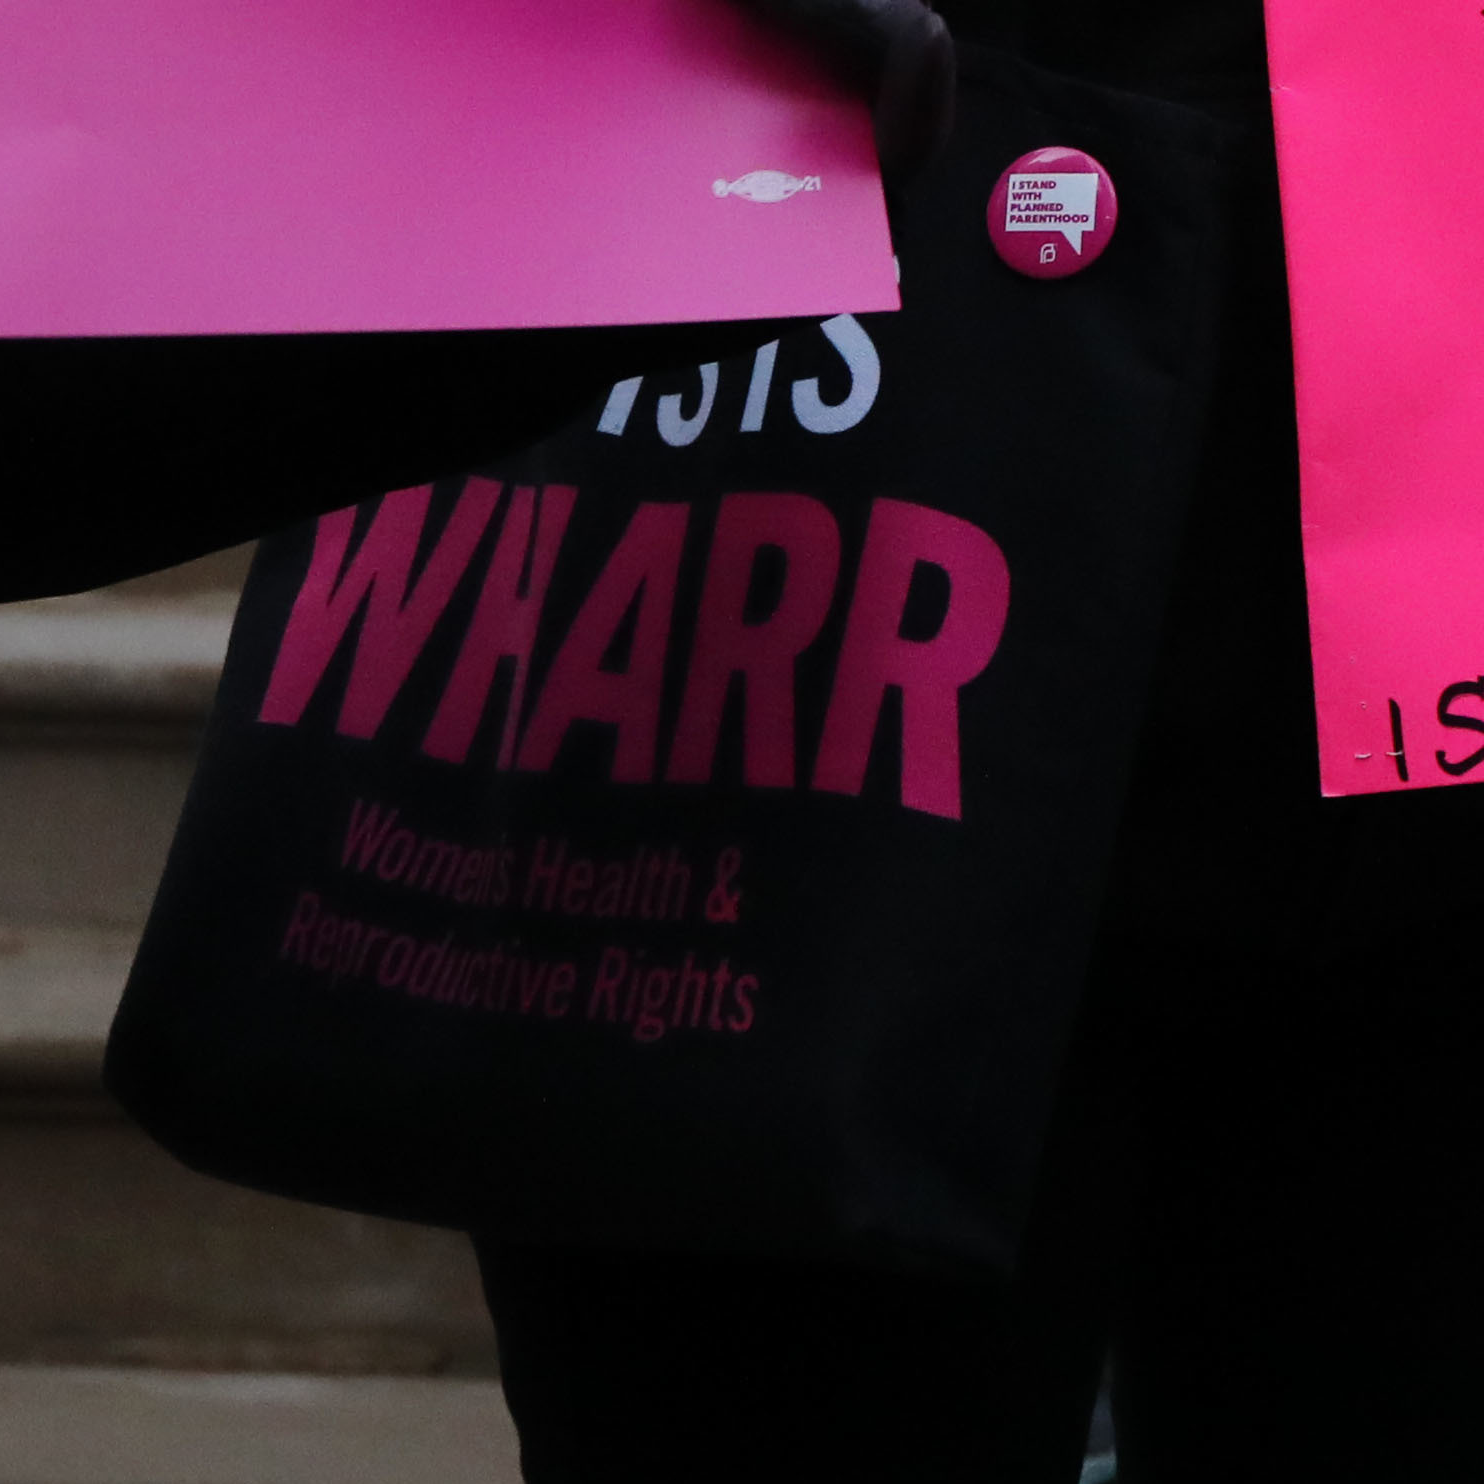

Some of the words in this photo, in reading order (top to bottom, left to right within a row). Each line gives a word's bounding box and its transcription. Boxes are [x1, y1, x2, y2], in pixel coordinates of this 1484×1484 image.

[1019, 180, 1057, 190] STAND
[1012, 192, 1042, 201] WITH
[1010, 203, 1064, 213] PLANNED
[1009, 214, 1090, 224] PARENTHOOD
[256, 475, 1012, 821] WHARR
[523, 835, 695, 923] Health
[703, 845, 745, 925] &
[279, 888, 579, 1024] Reproductive
[586, 943, 762, 1045] Rights
